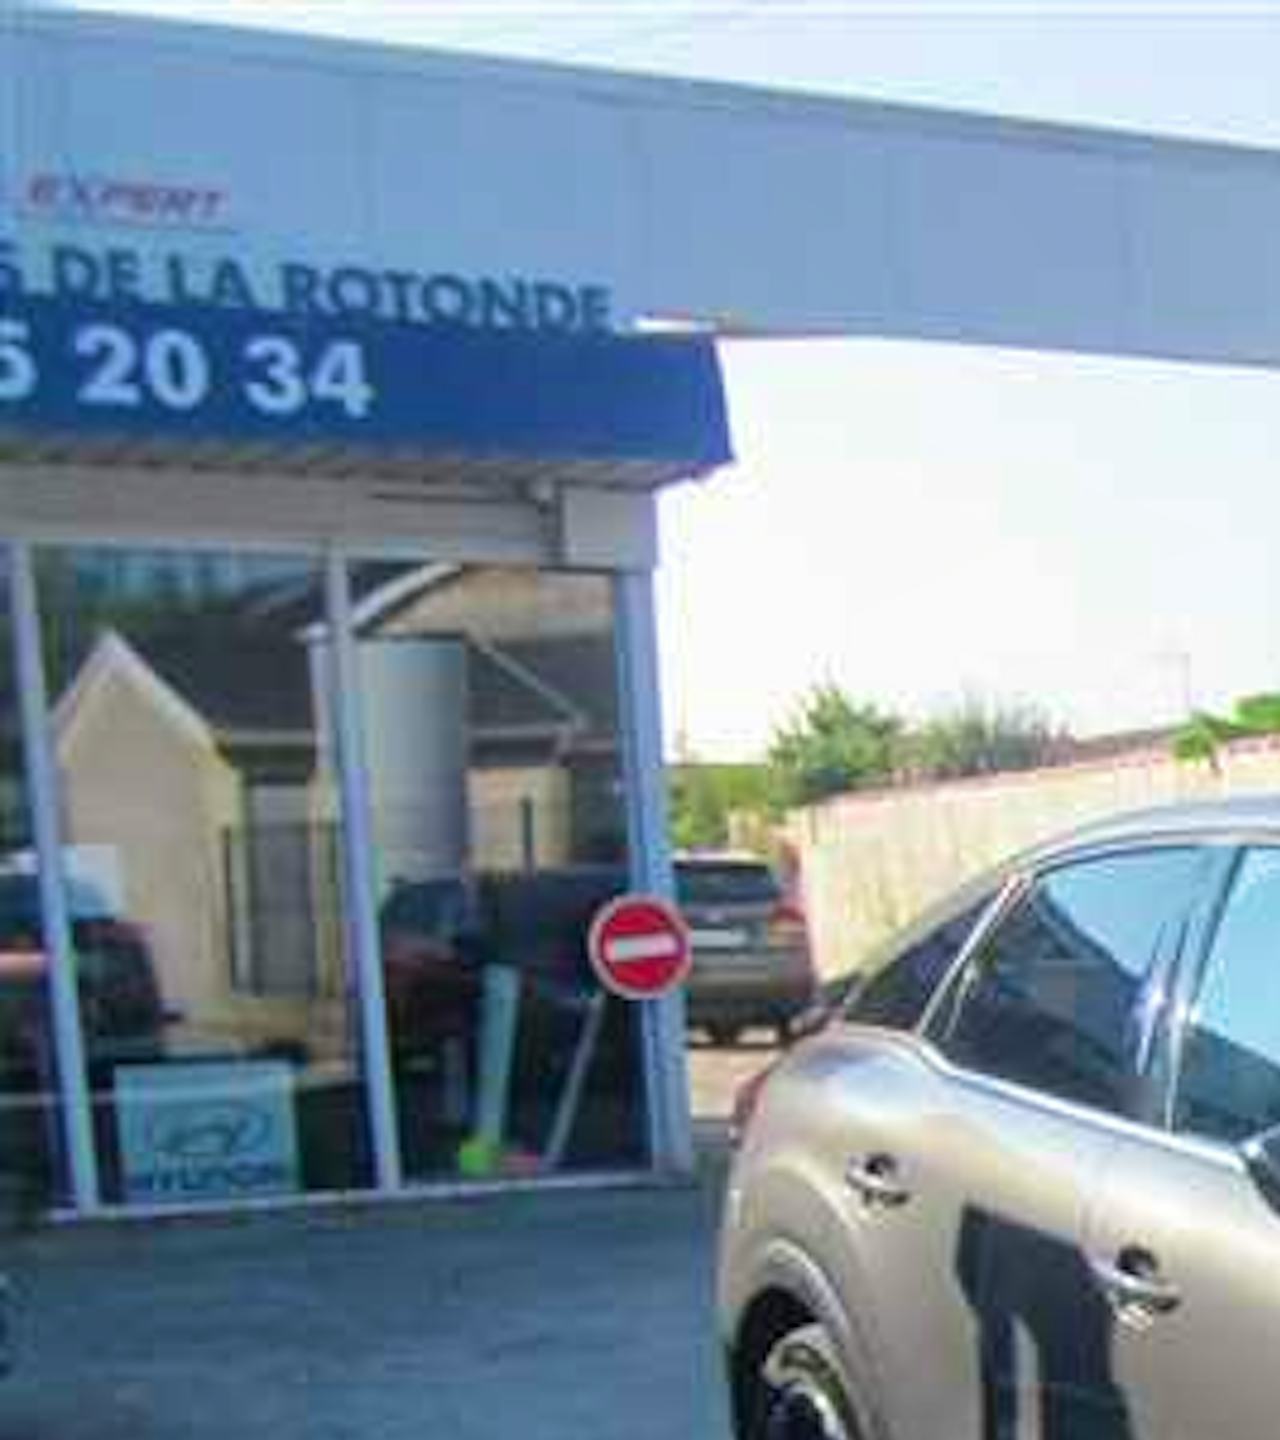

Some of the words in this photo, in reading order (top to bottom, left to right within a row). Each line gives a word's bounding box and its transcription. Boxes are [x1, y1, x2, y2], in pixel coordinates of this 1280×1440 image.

[52, 247, 141, 302] DE
[166, 253, 253, 310] LA
[281, 263, 613, 331] ROTONDE
[74, 324, 209, 411] 20
[241, 335, 374, 419] 34
